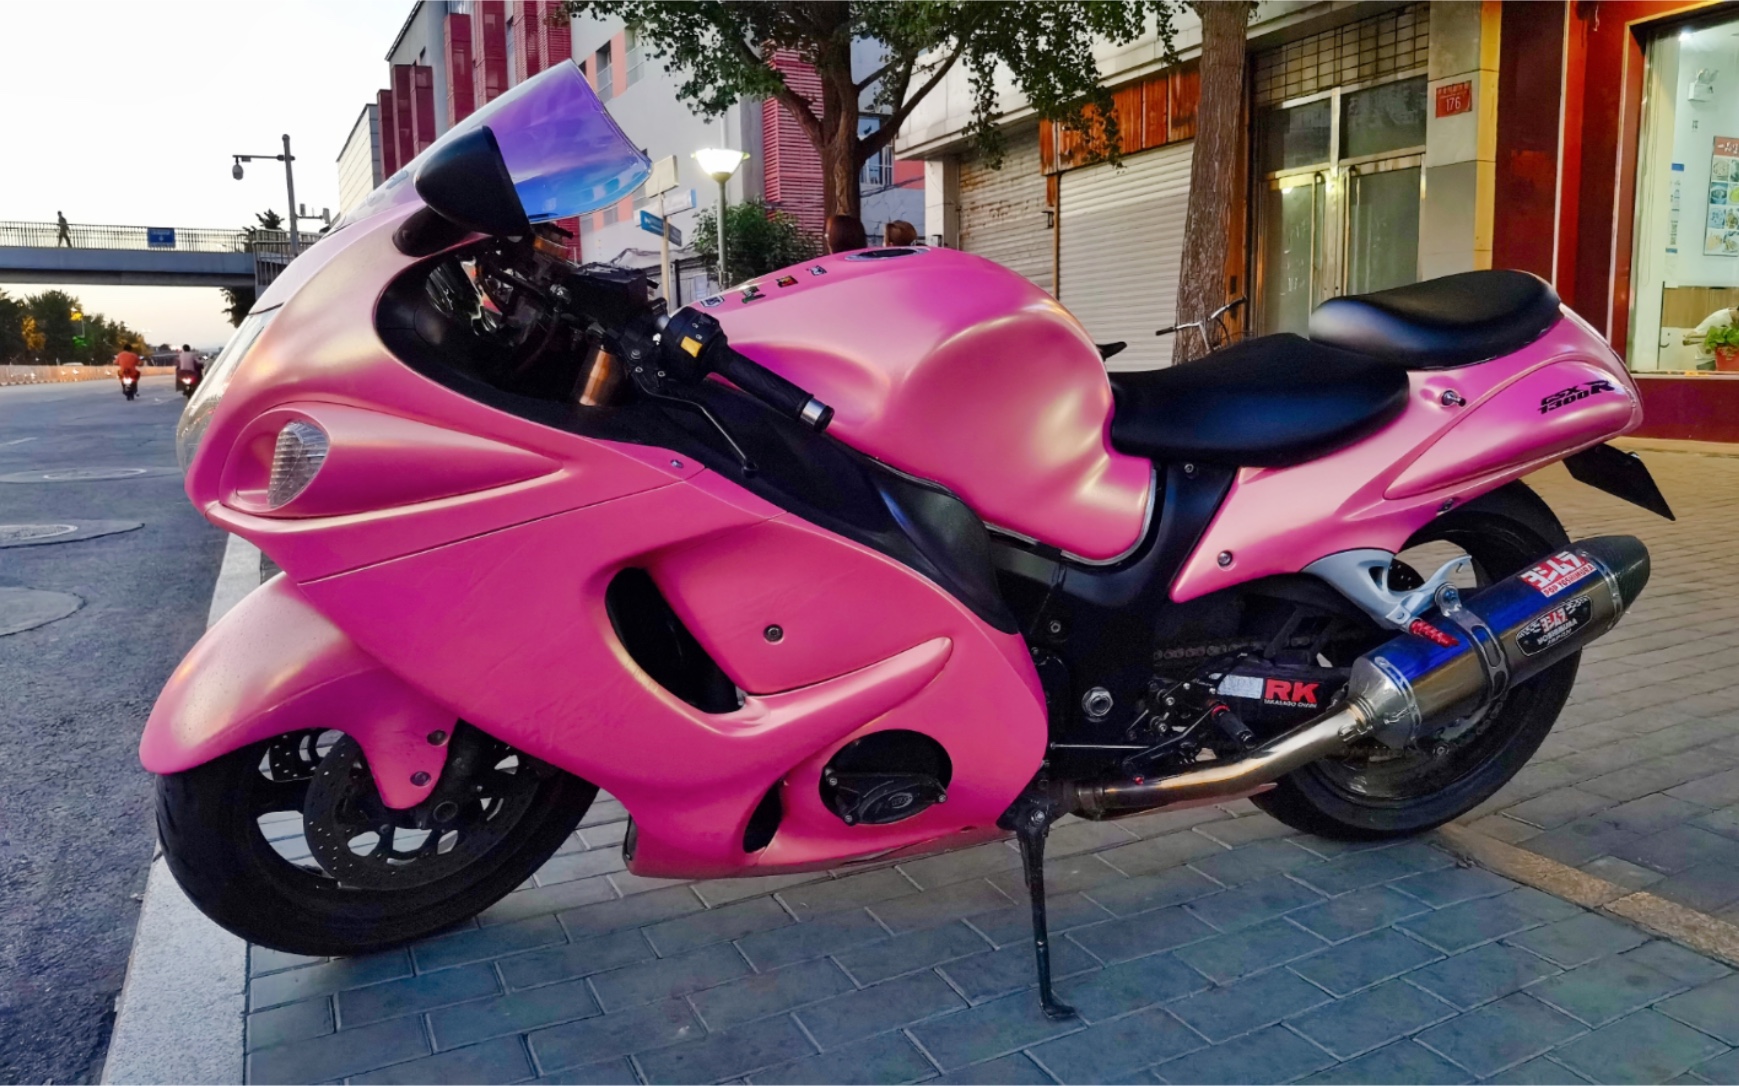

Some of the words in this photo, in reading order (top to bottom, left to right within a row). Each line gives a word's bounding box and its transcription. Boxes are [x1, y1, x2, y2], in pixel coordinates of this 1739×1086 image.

[1446, 96, 1462, 113] 176
[1537, 390, 1590, 415] 1300
[1541, 386, 1580, 406] GSX
[1543, 585, 1559, 596] POP
[1557, 564, 1595, 588] YOSHIMURA
[1265, 679, 1319, 703] RK
